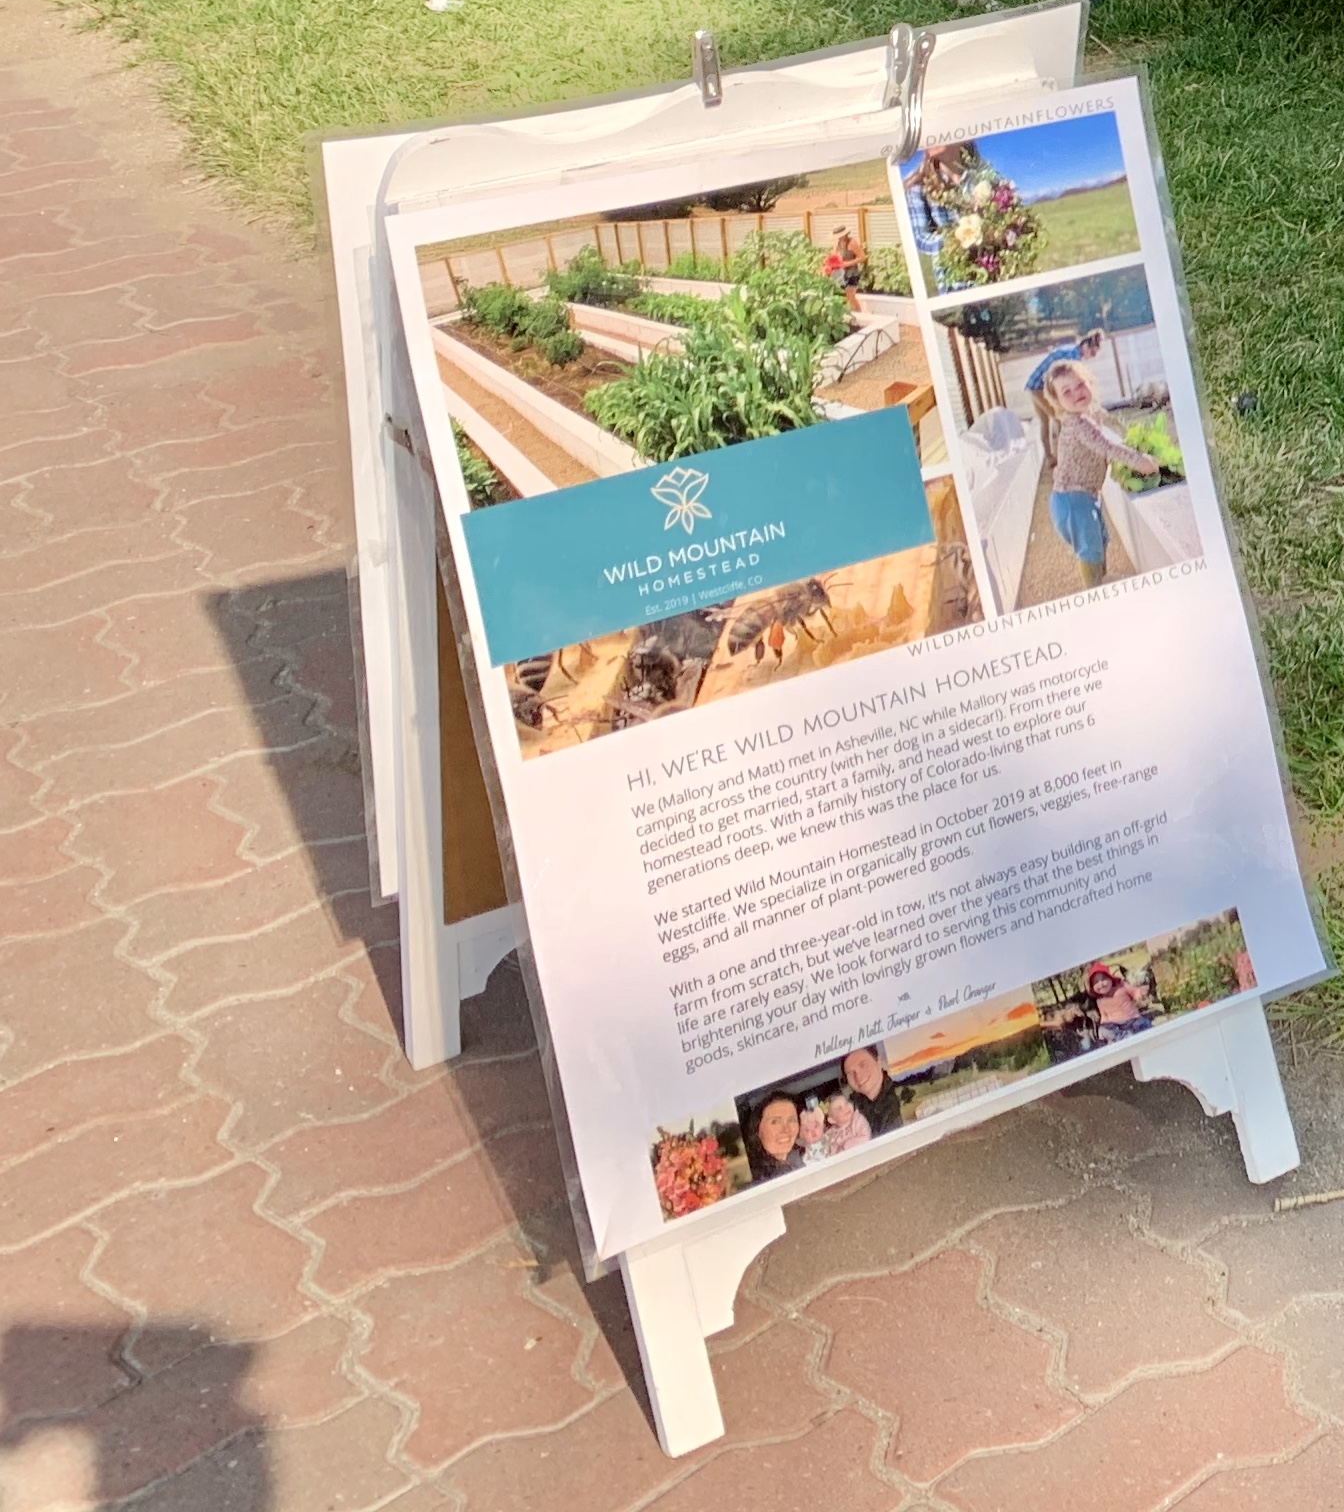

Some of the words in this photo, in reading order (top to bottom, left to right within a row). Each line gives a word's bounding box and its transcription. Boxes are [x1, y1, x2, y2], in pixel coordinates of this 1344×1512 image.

[880, 96, 1115, 158] @DMOUNTAINFLOWERS
[603, 555, 662, 584] WILD
[668, 521, 785, 567] MOUNTAIN
[638, 553, 760, 596] HOMESTEAD
[664, 595, 689, 611] 2019
[906, 558, 1207, 657] WILDMOUNTAINHOMESTEAD.COM
[627, 768, 656, 792] HI,
[661, 743, 728, 778] WE'RE
[734, 724, 794, 756] WILD
[804, 682, 926, 736] MOUNTAIN
[935, 642, 1067, 694] HOMESTEAD.
[631, 802, 655, 819] We
[658, 783, 714, 813] (Mallory
[718, 770, 745, 791] and
[747, 759, 785, 781] Matt)
[788, 750, 816, 769] met
[818, 746, 832, 759] in
[835, 726, 897, 754] Asheville,
[899, 716, 919, 733] NC
[922, 706, 957, 726] while
[959, 690, 1007, 714] Mallory
[1010, 682, 1036, 698] was
[1039, 659, 1109, 690] motorcycle
[636, 808, 697, 837] camping
[699, 793, 745, 816] across
[747, 784, 772, 800] the
[775, 765, 827, 791] country
[830, 752, 864, 776] (with
[866, 745, 889, 762] her
[893, 736, 920, 753] dog
[921, 732, 935, 744] in
[938, 728, 946, 740] a
[1009, 698, 1044, 716] From
[1046, 686, 1081, 705] there
[1084, 680, 1103, 693] we
[640, 824, 696, 855] decided
[698, 822, 714, 835] to
[717, 812, 740, 833] get
[743, 790, 803, 820] married,
[805, 780, 837, 800] start
[841, 777, 849, 789] a
[852, 762, 895, 785] family,
[898, 750, 924, 770] and
[926, 738, 960, 761] head
[962, 730, 994, 749] west
[996, 726, 1010, 738] to
[1013, 709, 1061, 733] explore
[1065, 701, 1086, 716] our
[643, 834, 723, 873] homestead
[726, 824, 767, 845] roots.
[770, 809, 803, 830] With
[806, 807, 815, 818] a
[817, 792, 858, 815] family
[860, 776, 906, 800] history
[910, 767, 923, 784] of
[926, 739, 1024, 778] Colorado-living
[1025, 729, 1052, 746] that
[1055, 719, 1084, 737] runs
[647, 854, 731, 895] generations
[734, 841, 774, 861] deep,
[776, 832, 797, 847] we
[800, 818, 836, 839] knew
[839, 809, 865, 826] this
[867, 799, 894, 816] was
[896, 791, 919, 807] the
[922, 778, 957, 802] place
[960, 771, 978, 785] for
[982, 765, 1001, 779] us.
[653, 910, 678, 927] We
[681, 888, 732, 918] started
[734, 876, 766, 898] Wild
[769, 856, 836, 887] Mountain
[839, 825, 917, 863] Homestead
[919, 823, 933, 835] in
[935, 803, 988, 829] October
[992, 789, 1025, 811] 2019
[1029, 785, 1041, 799] at
[1044, 771, 1079, 793] 8,000
[1082, 764, 1107, 781] feet
[1110, 760, 1122, 772] in
[657, 911, 730, 945] Westcliffe.
[732, 901, 757, 918] We
[760, 878, 827, 910] specialize
[829, 871, 843, 885] in
[846, 845, 917, 879] organically
[921, 831, 962, 857] grown
[965, 822, 986, 838] cut
[988, 806, 1038, 830] flowers,
[1040, 788, 1091, 812] veggies,
[1093, 766, 1158, 795] free-range
[662, 942, 699, 964] eggs,
[703, 926, 729, 949] and
[733, 920, 749, 938] all
[752, 902, 806, 931] manner
[810, 893, 824, 910] of
[828, 858, 927, 908] plant-powered
[930, 845, 974, 873] goods.
[669, 977, 703, 999] With
[707, 974, 716, 986] a
[719, 963, 746, 981] one
[750, 948, 777, 970] and
[779, 912, 878, 959] three-year-old
[880, 910, 894, 923] in
[896, 899, 925, 917] tow,
[928, 890, 946, 906] it's
[949, 881, 972, 899] not
[975, 866, 1017, 890] always
[1020, 855, 1048, 873] easy
[1050, 836, 1103, 862] building
[1105, 830, 1120, 844] an
[1123, 810, 1167, 837] off-grid
[673, 996, 708, 1017] farm
[711, 982, 746, 1003] from
[749, 960, 803, 990] scratch,
[806, 950, 831, 968] but
[832, 937, 871, 958] we've
[873, 913, 926, 944] learned
[928, 905, 957, 924] over
[960, 896, 983, 913] the
[985, 883, 1021, 908] years
[1023, 872, 1049, 891] that
[1052, 865, 1074, 880] the
[1075, 852, 1104, 871] best
[1106, 839, 1145, 860] things
[1147, 834, 1159, 846] in
[677, 1018, 699, 1035] life
[703, 1009, 727, 1026] are
[730, 991, 770, 1016] rarely
[810, 968, 834, 984] We
[836, 954, 868, 976] look
[869, 933, 923, 964] forward
[925, 931, 940, 944] to
[942, 911, 991, 938] serving
[992, 902, 1017, 919] this
[1019, 876, 1090, 909] community
[1093, 863, 1117, 884] and
[681, 1013, 765, 1053] brightening
[765, 1000, 797, 1025] your
[801, 989, 826, 1008] day
[829, 977, 859, 997] with
[861, 957, 911, 986] lovingly
[915, 942, 957, 969] grown
[959, 924, 1007, 949] flowers
[1010, 911, 1035, 932] and
[1037, 882, 1114, 921] handcrafted
[1116, 872, 1152, 893] home
[685, 1046, 734, 1075] goods,
[736, 1021, 799, 1052] skincare,
[802, 1005, 829, 1027] and
[831, 993, 873, 1016] more.
